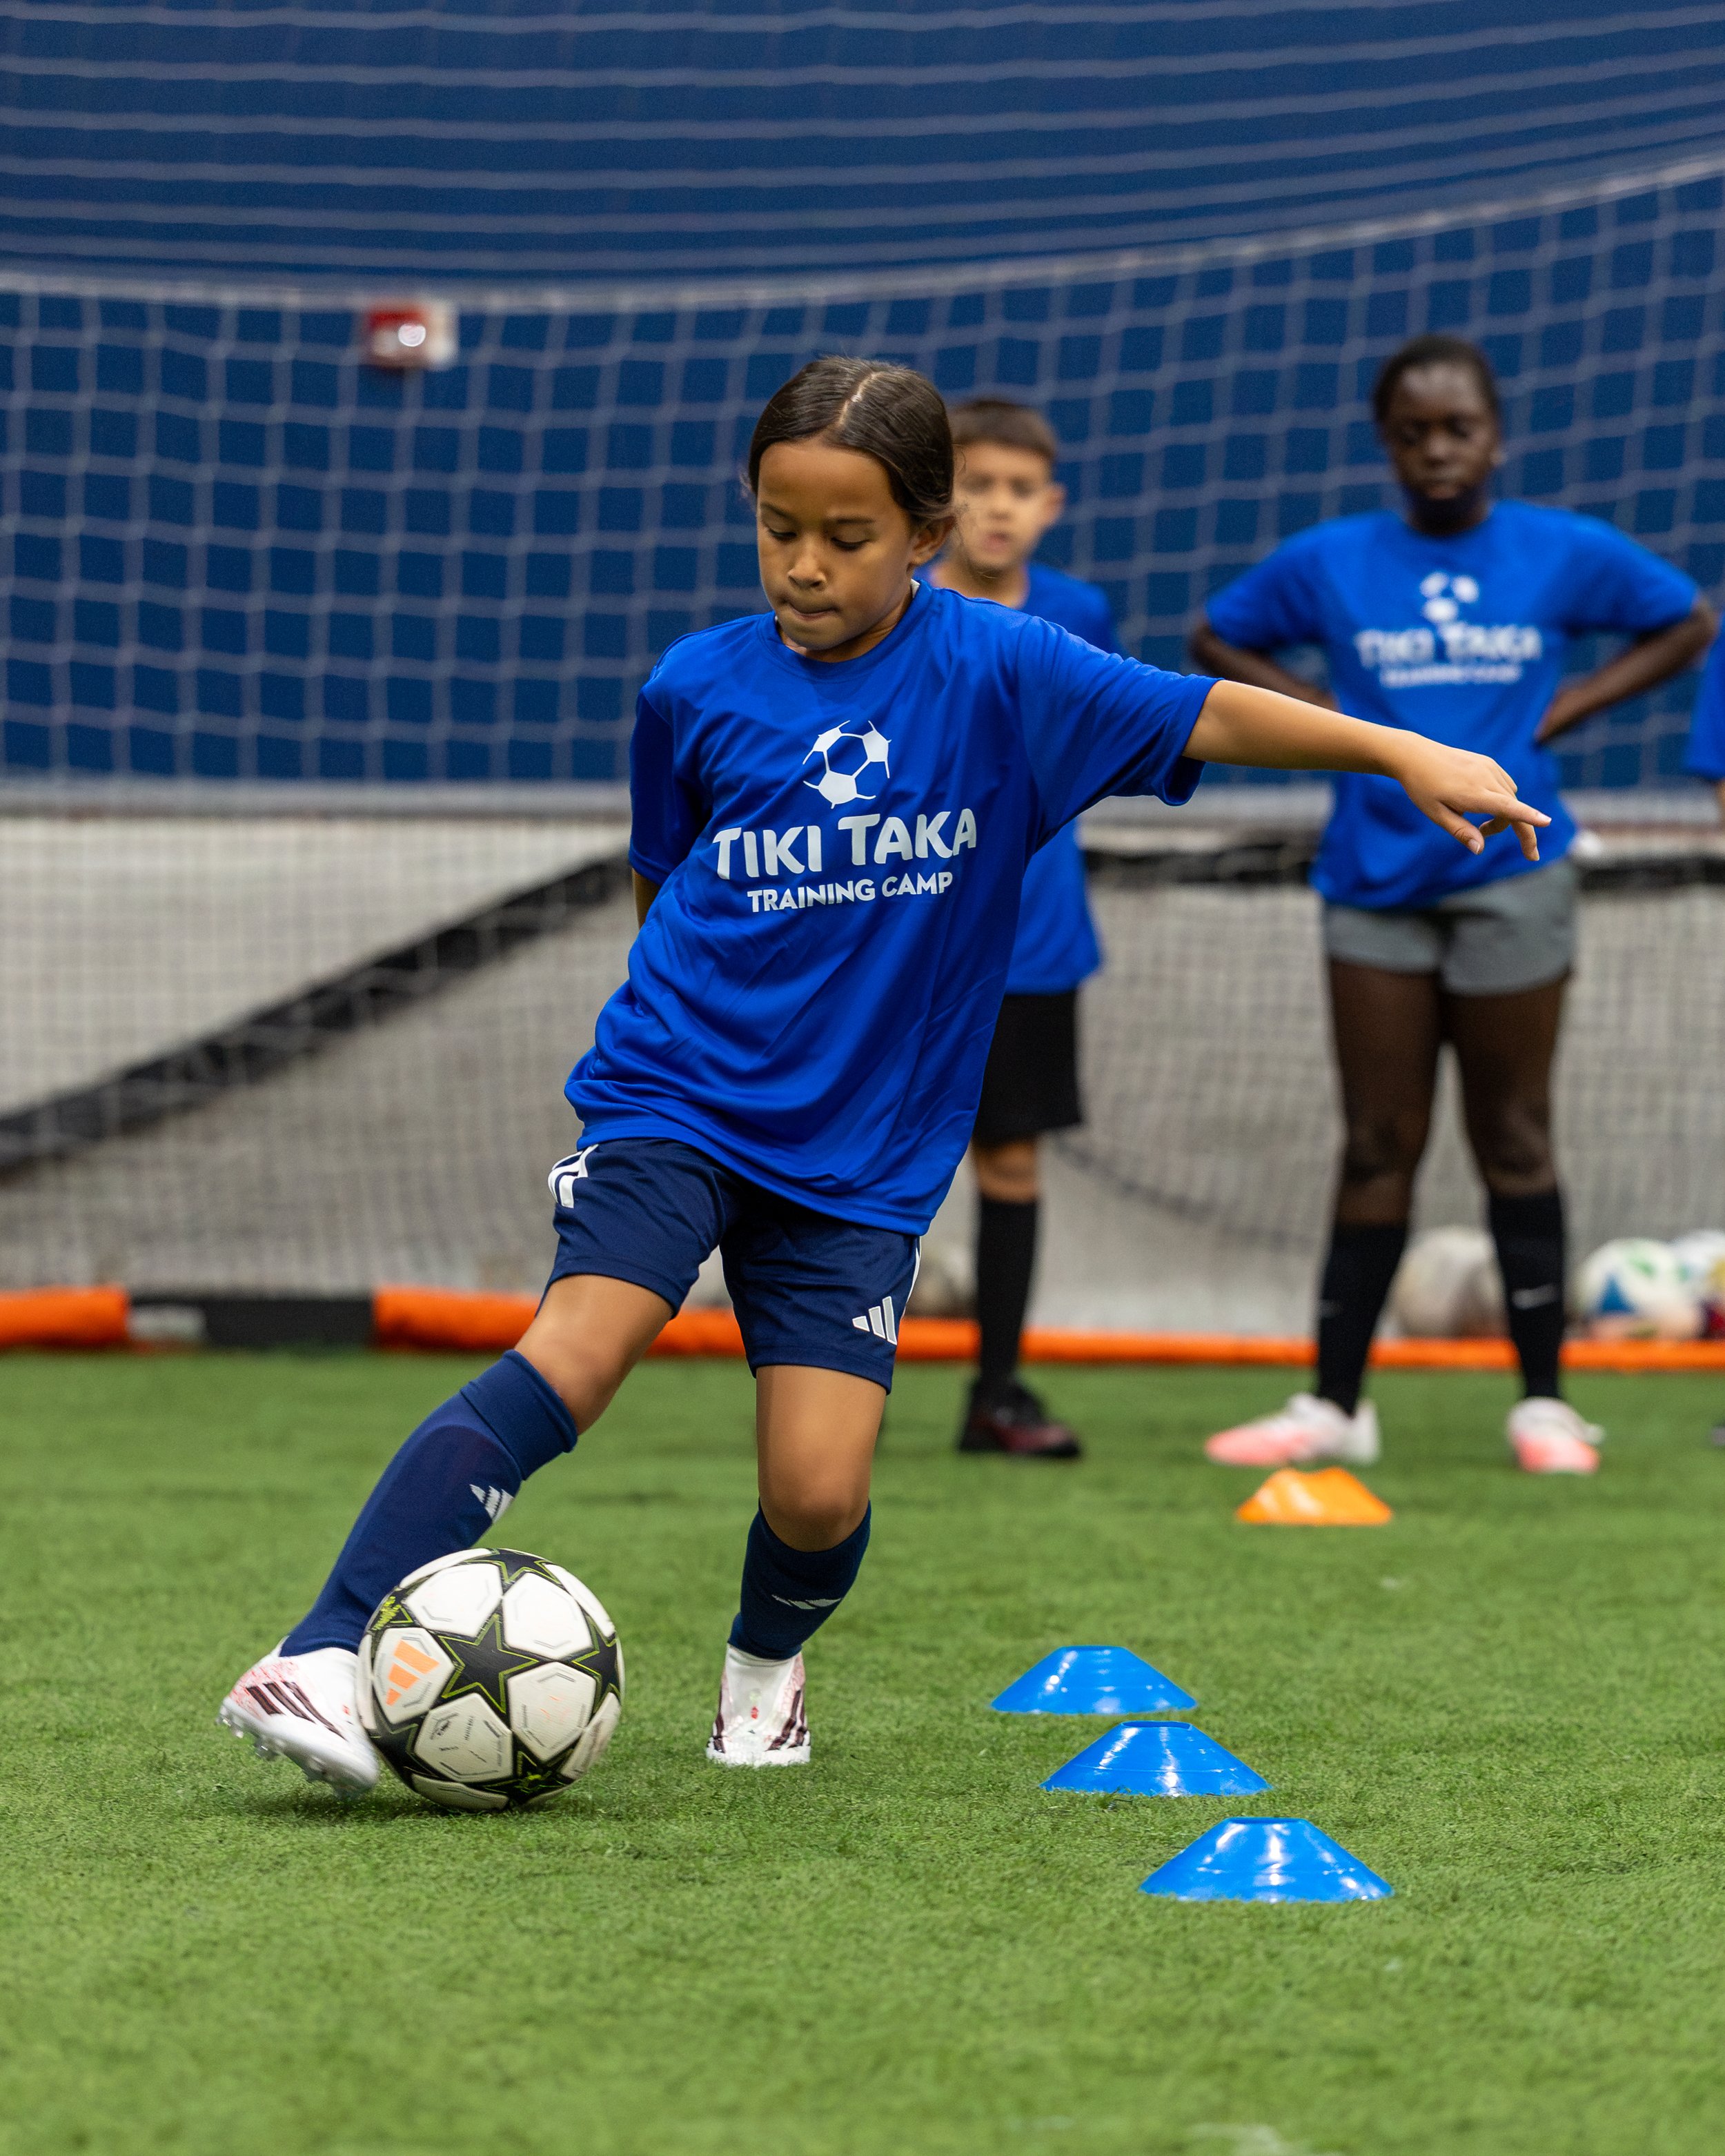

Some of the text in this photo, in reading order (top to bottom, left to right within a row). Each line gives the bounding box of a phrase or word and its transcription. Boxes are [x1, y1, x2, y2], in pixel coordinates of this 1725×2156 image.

[712, 808, 977, 880] TIKI TAKA
[747, 871, 953, 913] TRAINING CAMP
